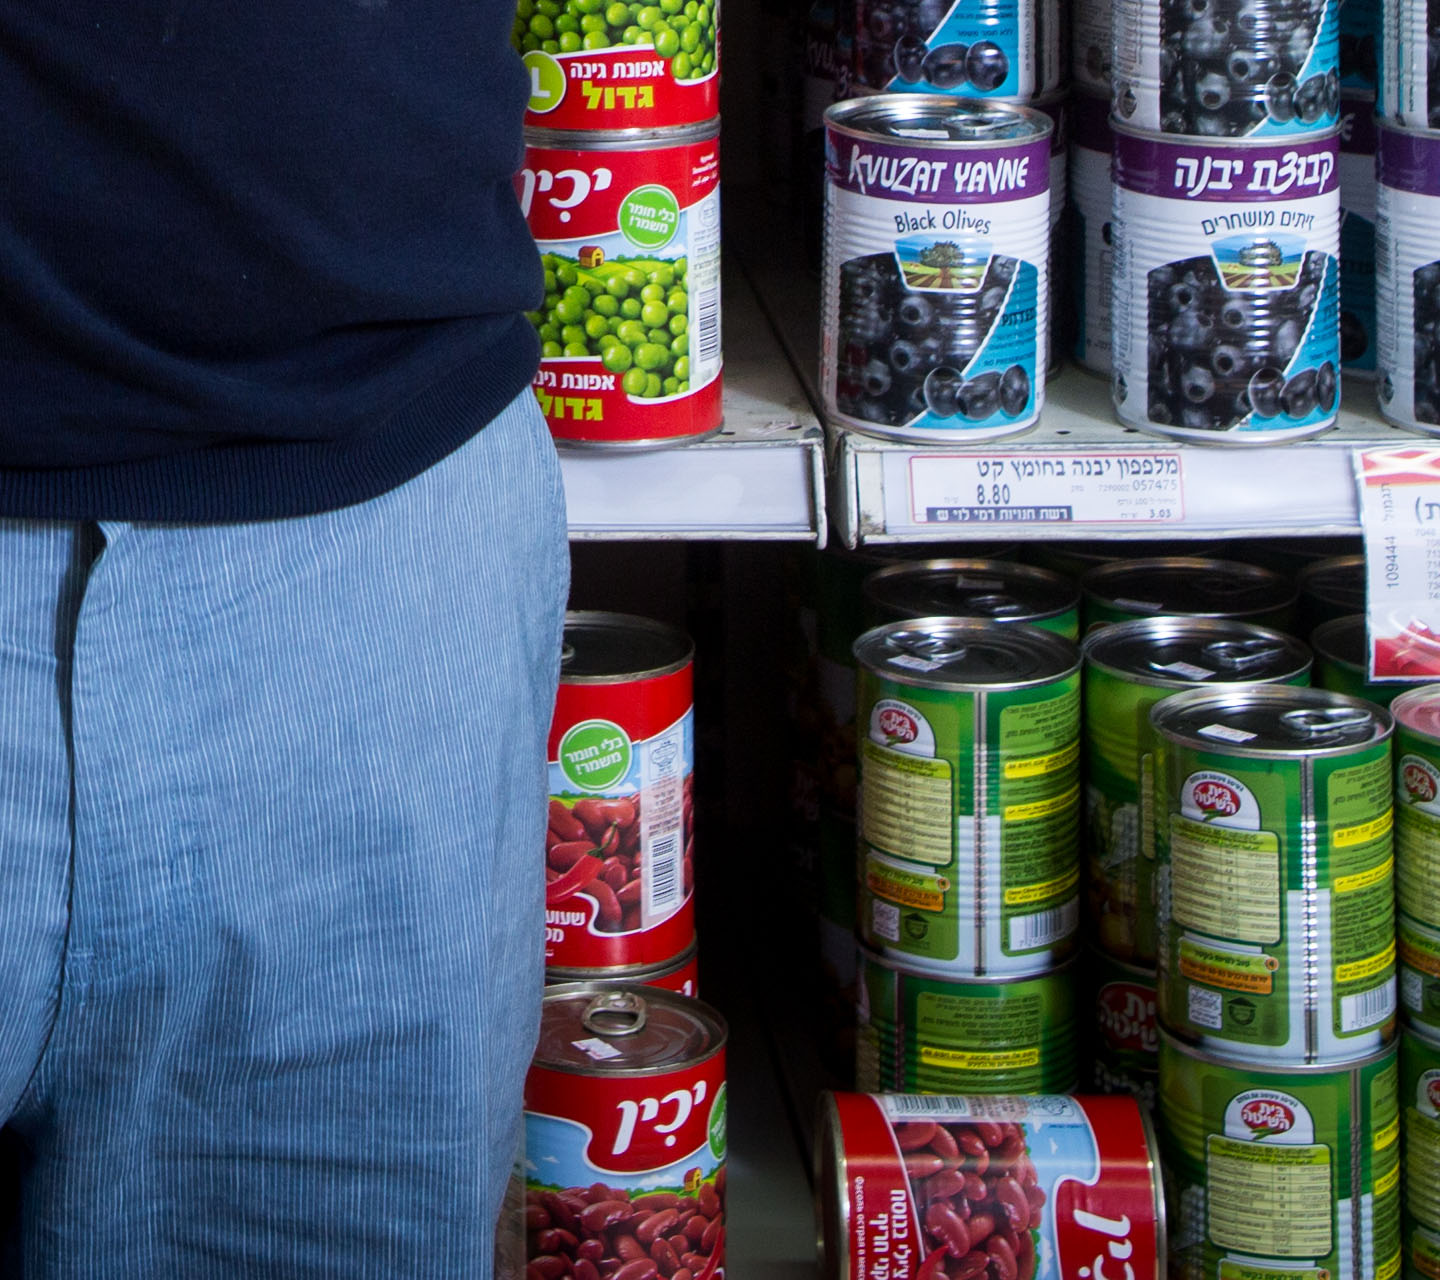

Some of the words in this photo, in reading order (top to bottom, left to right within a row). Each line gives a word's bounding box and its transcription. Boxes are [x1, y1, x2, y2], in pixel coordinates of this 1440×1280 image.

[570, 60, 604, 80] גינה
[610, 60, 664, 80] אפונת
[582, 80, 656, 112] גדול
[849, 144, 951, 196] KVUZAT
[954, 156, 1030, 195] YAVNE
[894, 210, 937, 236] Black
[942, 208, 992, 236] Olives
[1011, 458, 1066, 481] בחומץ
[1072, 458, 1110, 478] יבנה
[1119, 456, 1178, 480] מלפפון
[976, 484, 1011, 505] 8.80
